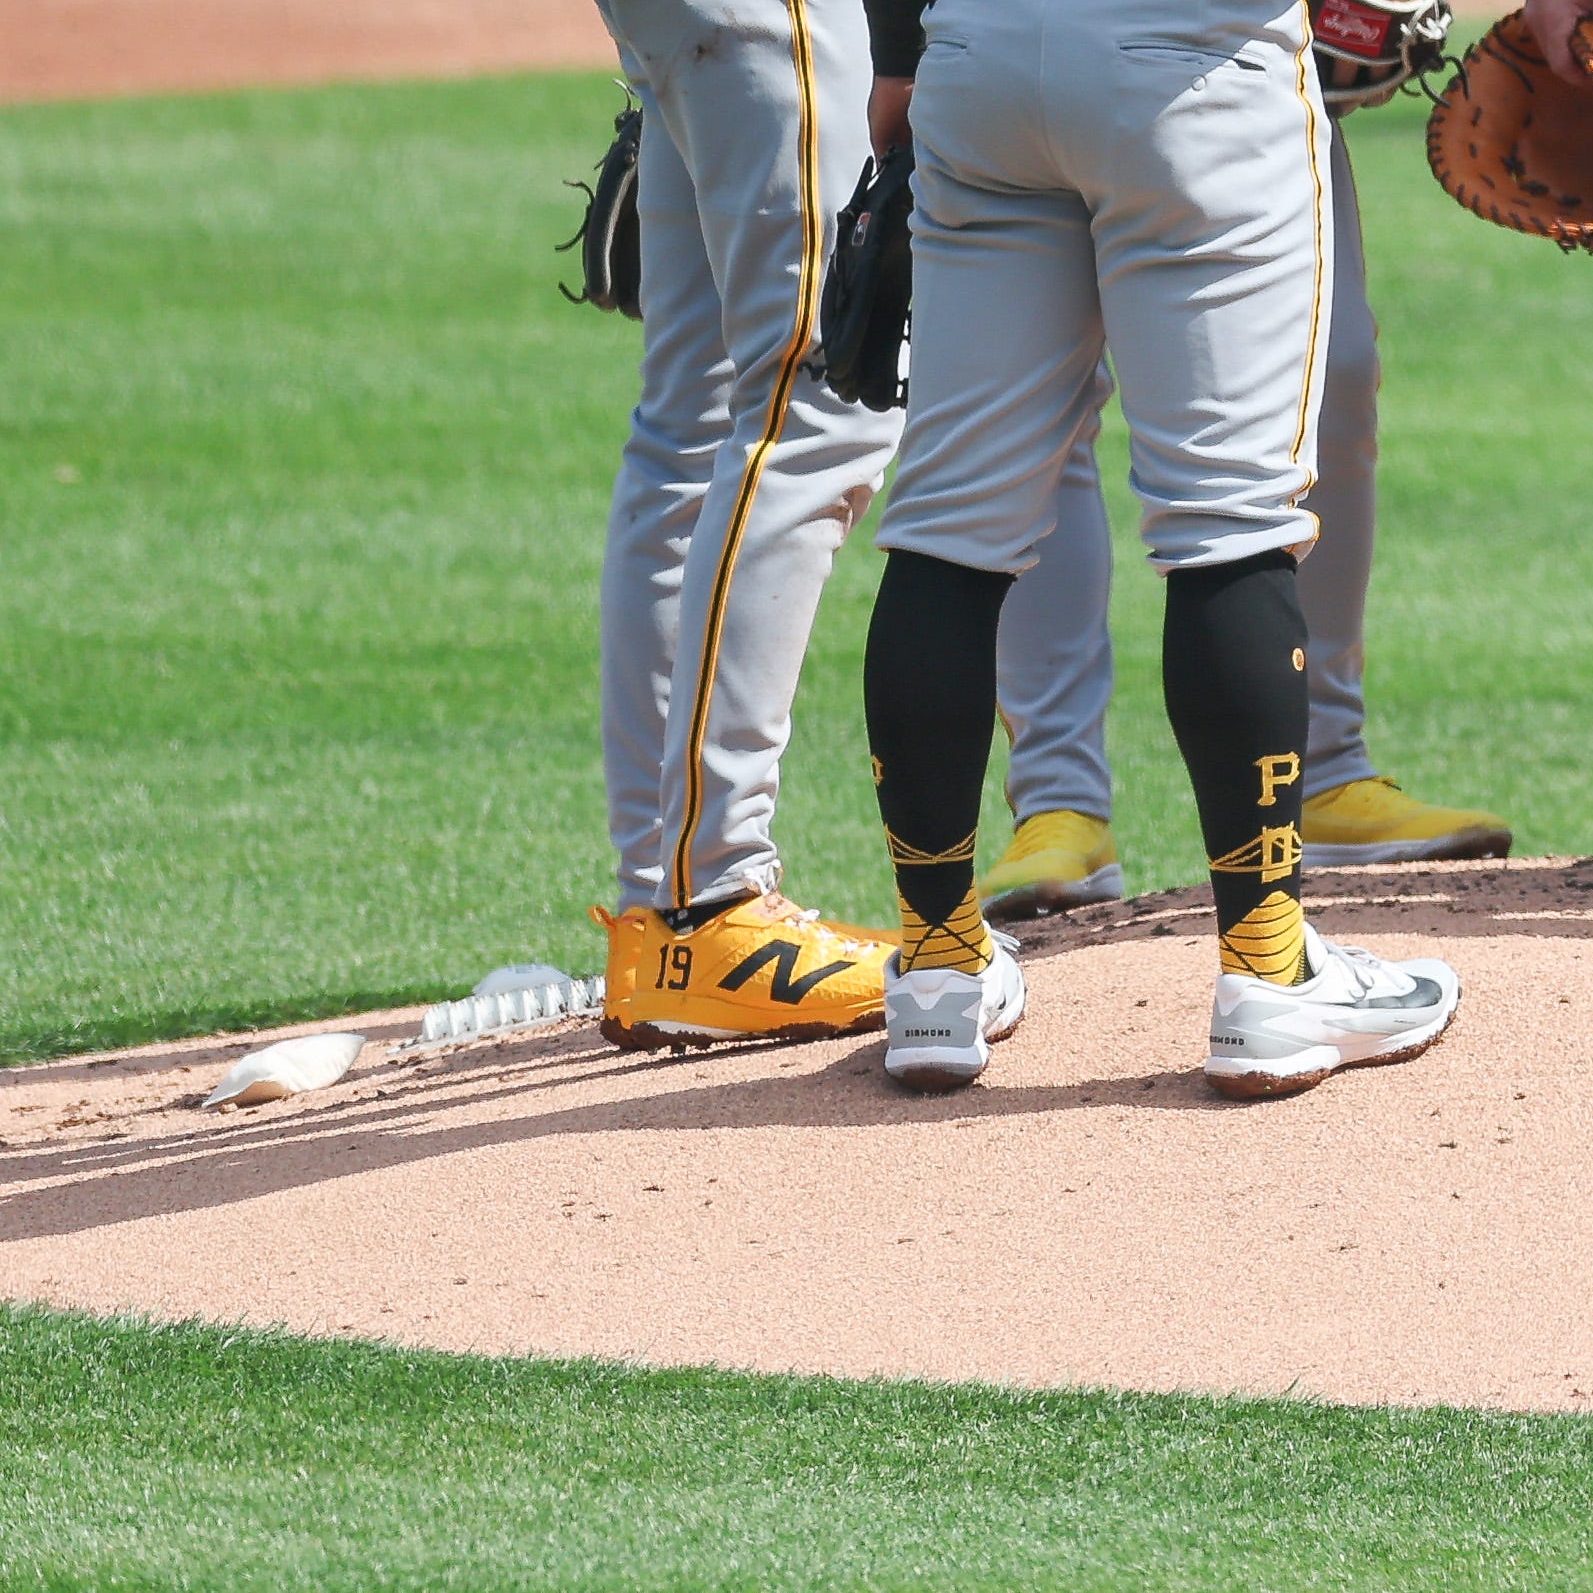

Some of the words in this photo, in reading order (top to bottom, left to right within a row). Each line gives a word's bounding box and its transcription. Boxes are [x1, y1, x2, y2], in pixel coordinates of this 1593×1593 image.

[1254, 751, 1301, 806] P
[655, 943, 693, 990] 19
[905, 1028, 951, 1038] DIAMOND
